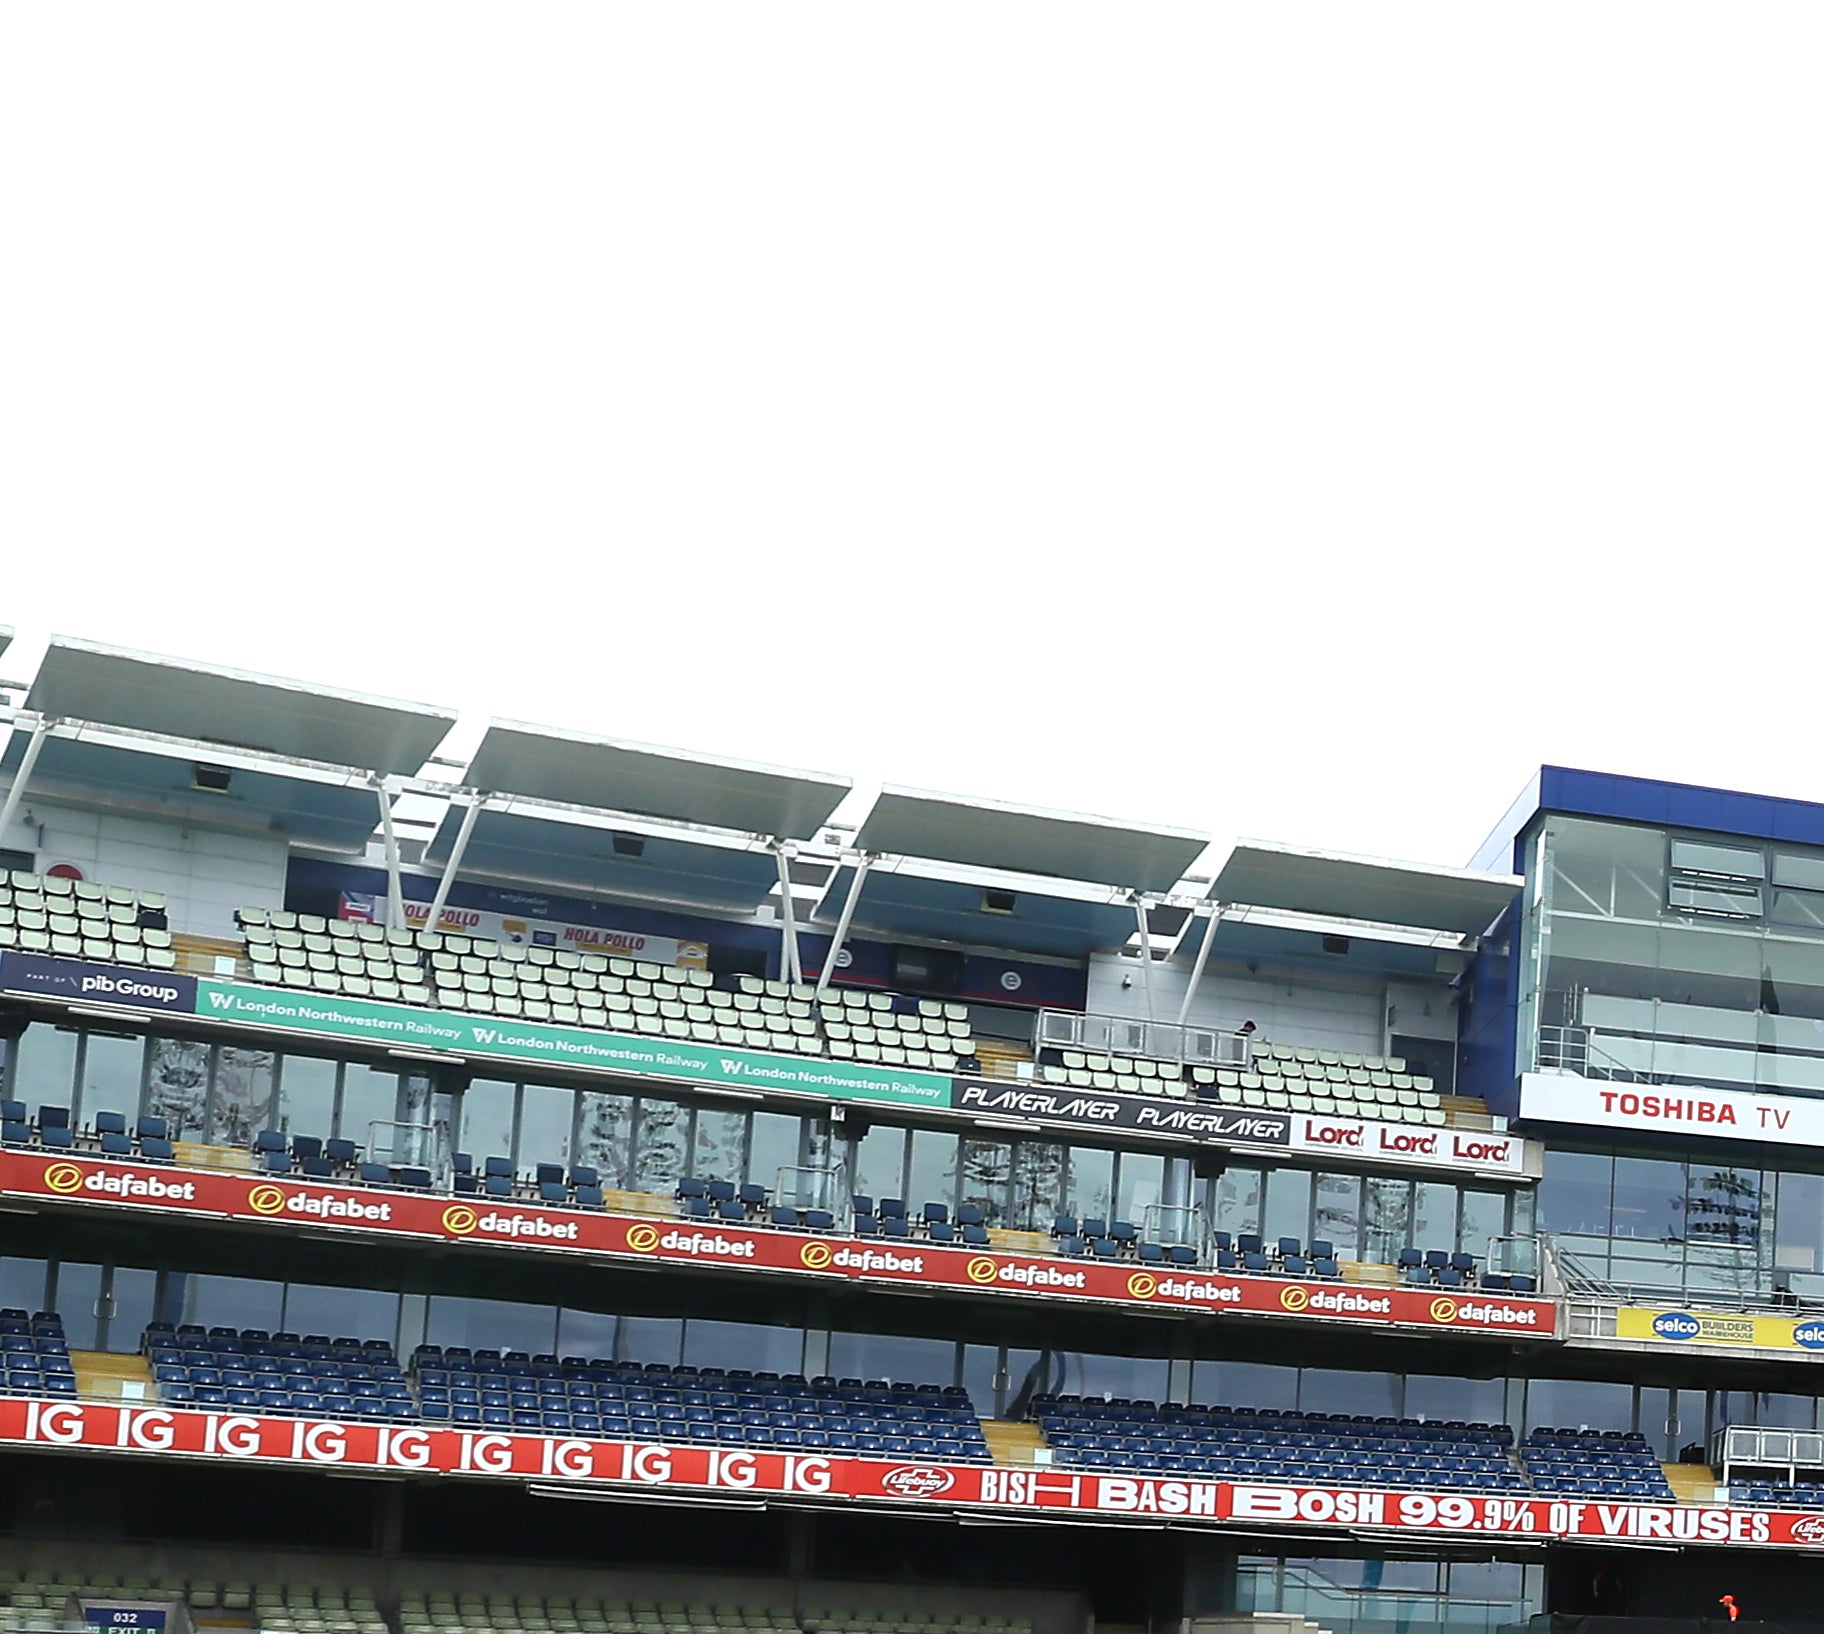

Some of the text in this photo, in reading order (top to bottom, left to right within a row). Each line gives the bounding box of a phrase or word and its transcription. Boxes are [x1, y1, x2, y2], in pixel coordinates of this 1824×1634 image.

[564, 928, 645, 951] HOLA POLLO
[82, 975, 177, 1002] pibGroup
[236, 999, 461, 1040] London Northwestern Railway
[498, 1033, 708, 1070] London Northwestern Railway
[745, 1065, 940, 1098] London Northwestern Railway
[961, 1086, 1121, 1121] PLAYERLAYER
[1600, 1092, 1790, 1129] TOSHIBA TV
[1137, 1107, 1286, 1140] PLAYERLAYER
[1304, 1120, 1364, 1146] Lord
[1380, 1128, 1437, 1154] Lord
[1453, 1136, 1510, 1162] Lord
[85, 1171, 195, 1199] dafabet
[287, 1193, 391, 1220] dafabet
[479, 1213, 578, 1239] dafabet
[661, 1231, 754, 1257] dafabet
[833, 1248, 923, 1272] dafabet
[999, 1263, 1085, 1287] dafabet
[1158, 1279, 1241, 1301] dafabet
[1310, 1291, 1390, 1312] dafabet
[1459, 1303, 1535, 1324] dafabet
[1656, 1318, 1697, 1333] selco
[25, 1402, 85, 1443] IG
[116, 1408, 175, 1449] IG
[204, 1415, 260, 1455] IG
[291, 1421, 347, 1461] IG
[377, 1427, 430, 1466] IG
[542, 1439, 594, 1477] IG
[621, 1443, 672, 1482] IG
[706, 1451, 757, 1488] IG
[783, 1456, 832, 1493] IG
[888, 1473, 949, 1489] Lifebuoy
[981, 1470, 1771, 1543] BISH BASH BOSH 99.9% OF VIRUSES
[113, 1613, 138, 1623] 032
